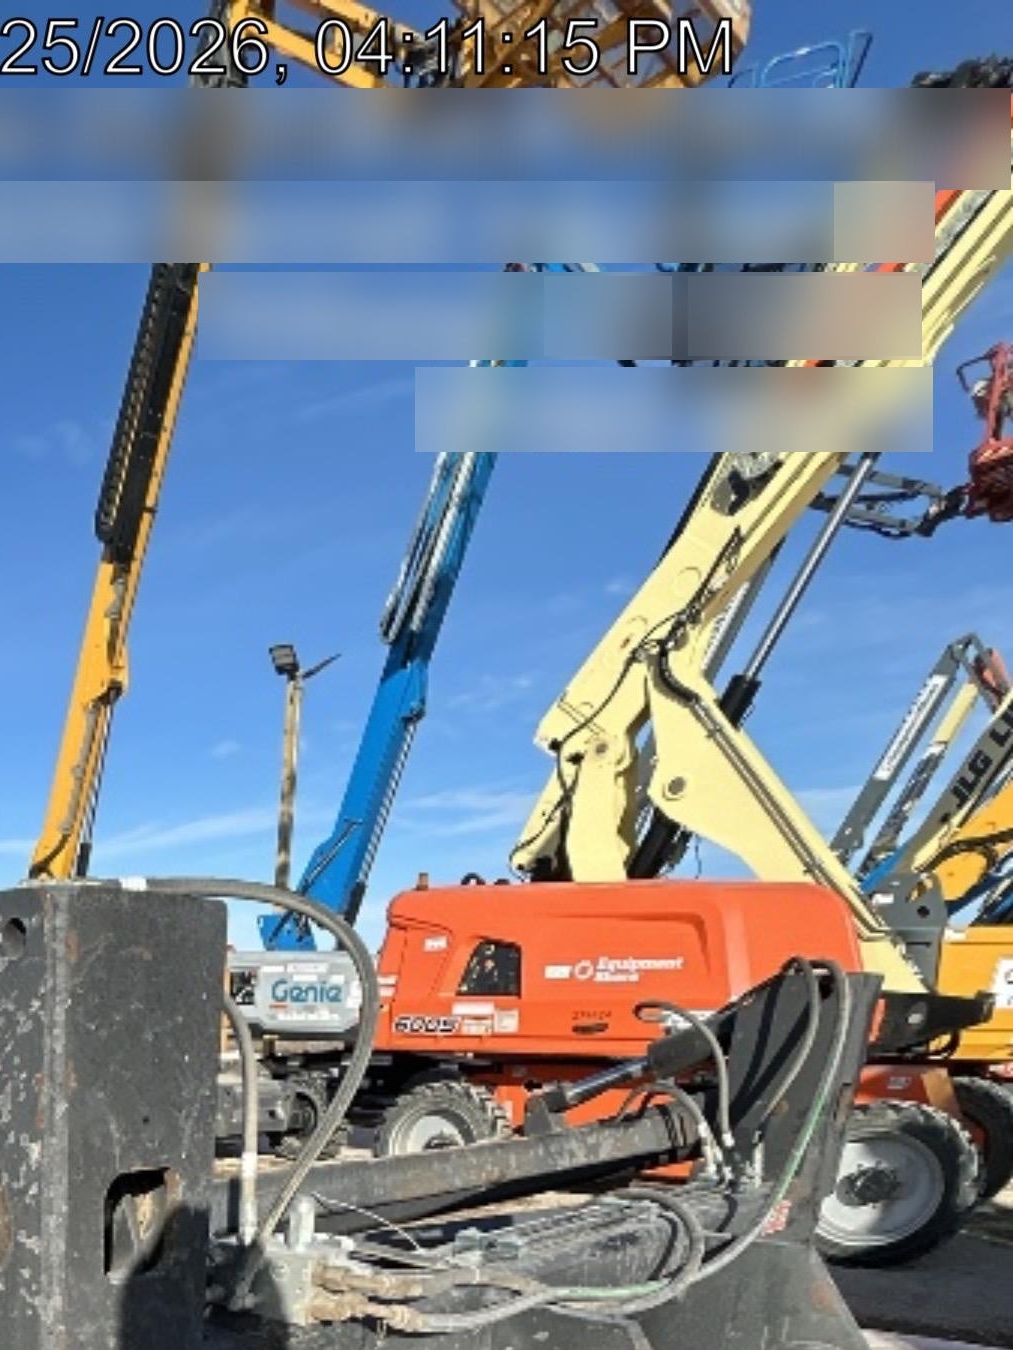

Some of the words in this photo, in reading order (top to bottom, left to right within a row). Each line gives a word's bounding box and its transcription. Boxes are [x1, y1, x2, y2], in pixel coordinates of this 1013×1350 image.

[951, 749, 993, 809] JLG
[595, 956, 684, 974] Equipment
[271, 979, 343, 1003] Genie
